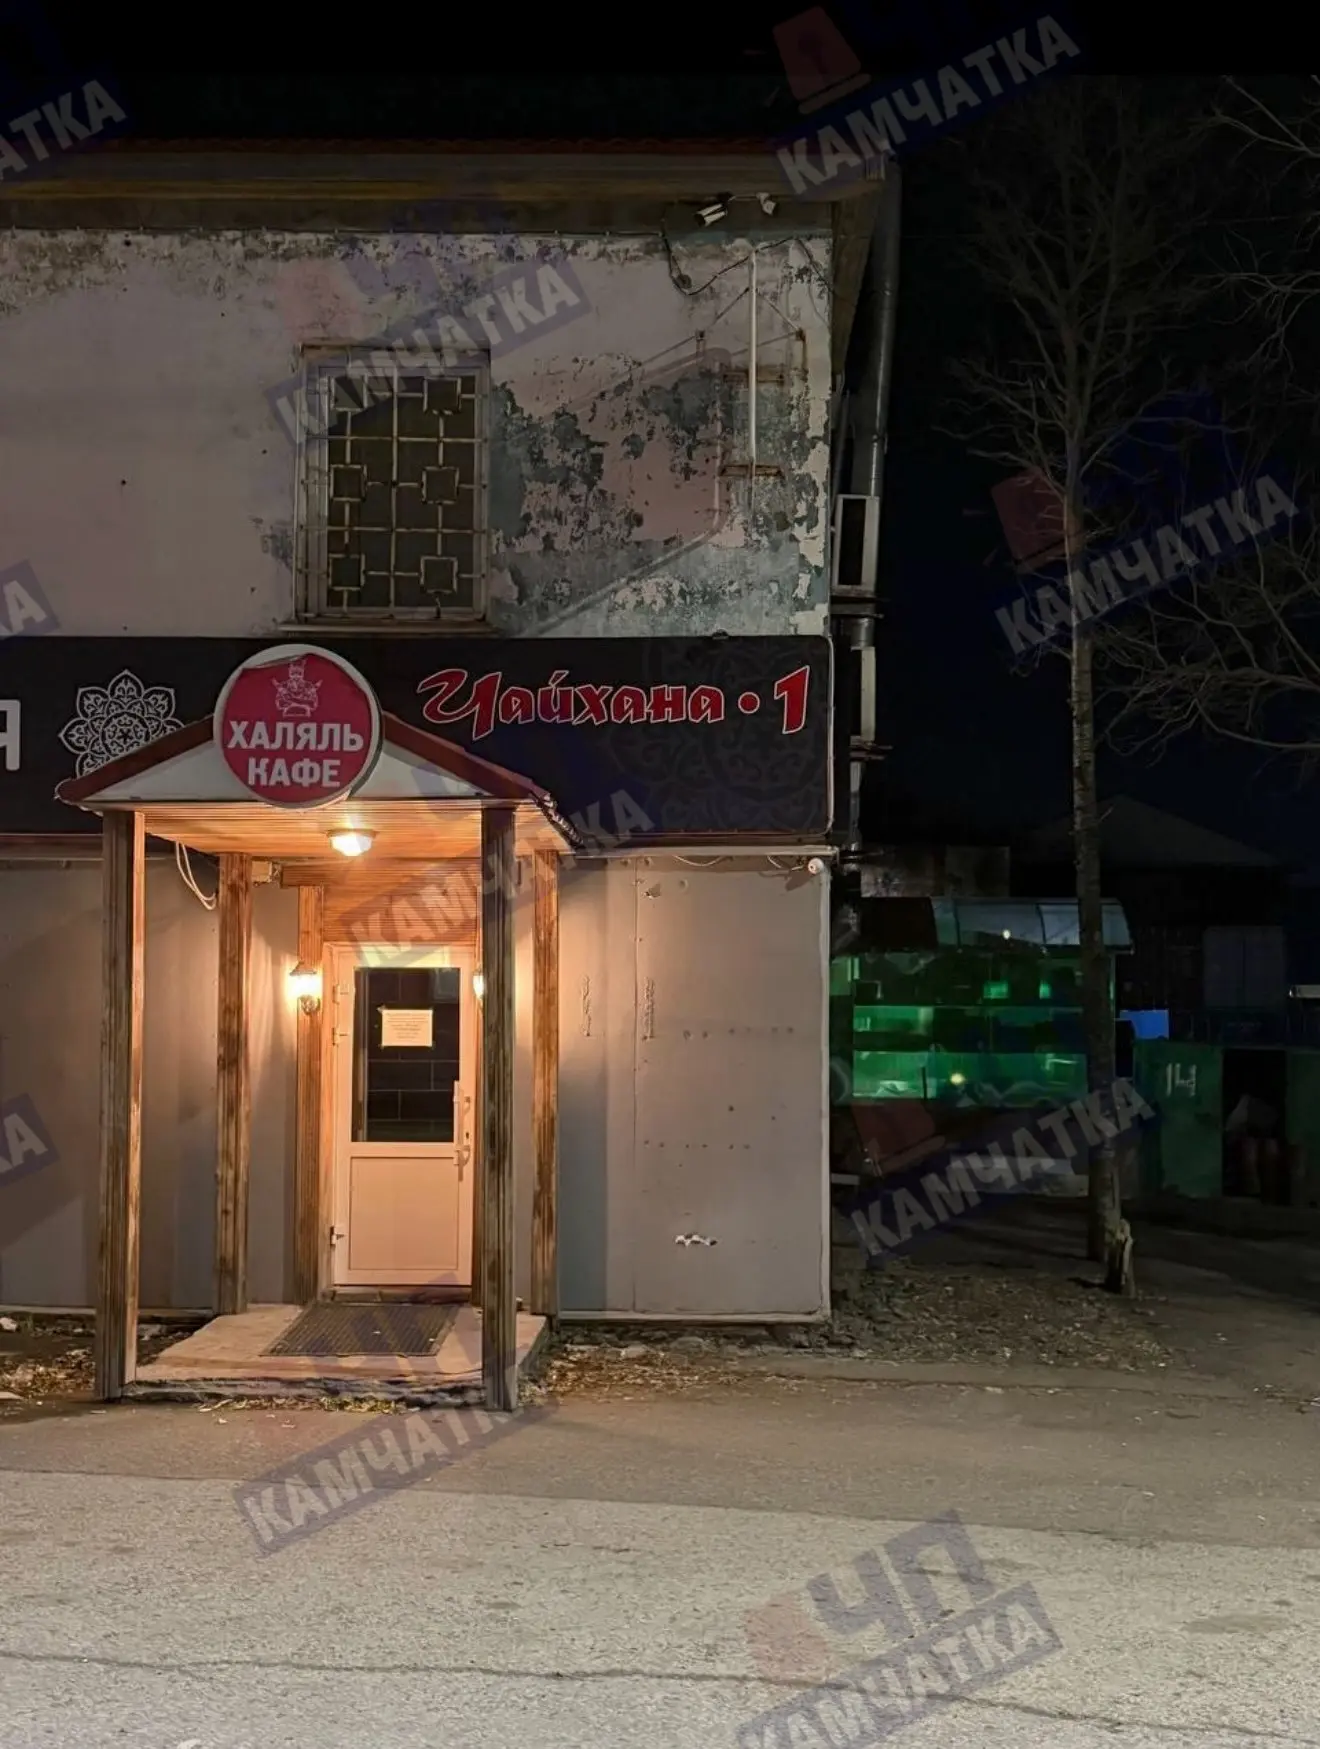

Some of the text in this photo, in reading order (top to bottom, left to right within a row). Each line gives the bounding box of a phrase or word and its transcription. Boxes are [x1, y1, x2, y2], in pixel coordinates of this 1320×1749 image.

[416, 664, 811, 742] Чайхана 1
[226, 719, 365, 752] ХАЛЯЛЬ
[247, 756, 342, 788] КАФЕ
[1165, 1062, 1197, 1098] 14
